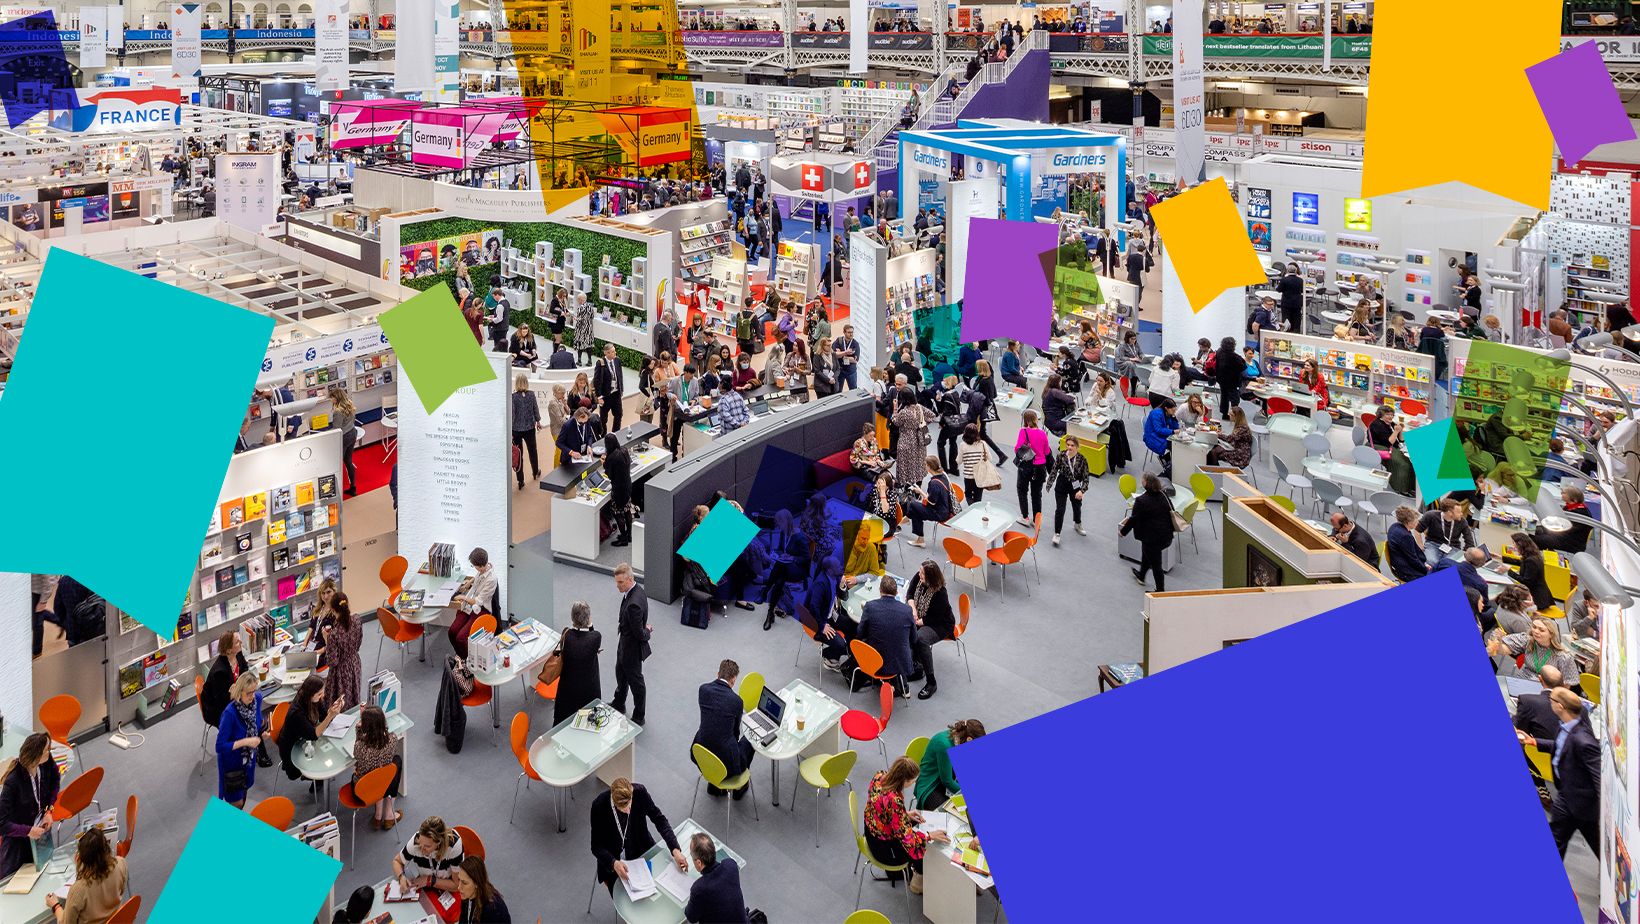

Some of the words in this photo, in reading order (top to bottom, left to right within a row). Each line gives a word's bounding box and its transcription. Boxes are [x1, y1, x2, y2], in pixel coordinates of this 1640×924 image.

[27, 31, 80, 41] Indonesi
[100, 108, 170, 124] FRANCE
[1182, 108, 1202, 129] 6D30
[348, 124, 395, 135] Germany
[414, 130, 453, 150] Germany
[642, 132, 682, 146] Germany
[1210, 136, 1224, 144] ipg
[1236, 137, 1252, 146] ipg
[1264, 138, 1280, 148] ipg
[1301, 142, 1332, 152] stison
[914, 150, 946, 168] Gardners
[1054, 154, 1106, 166] Gardners
